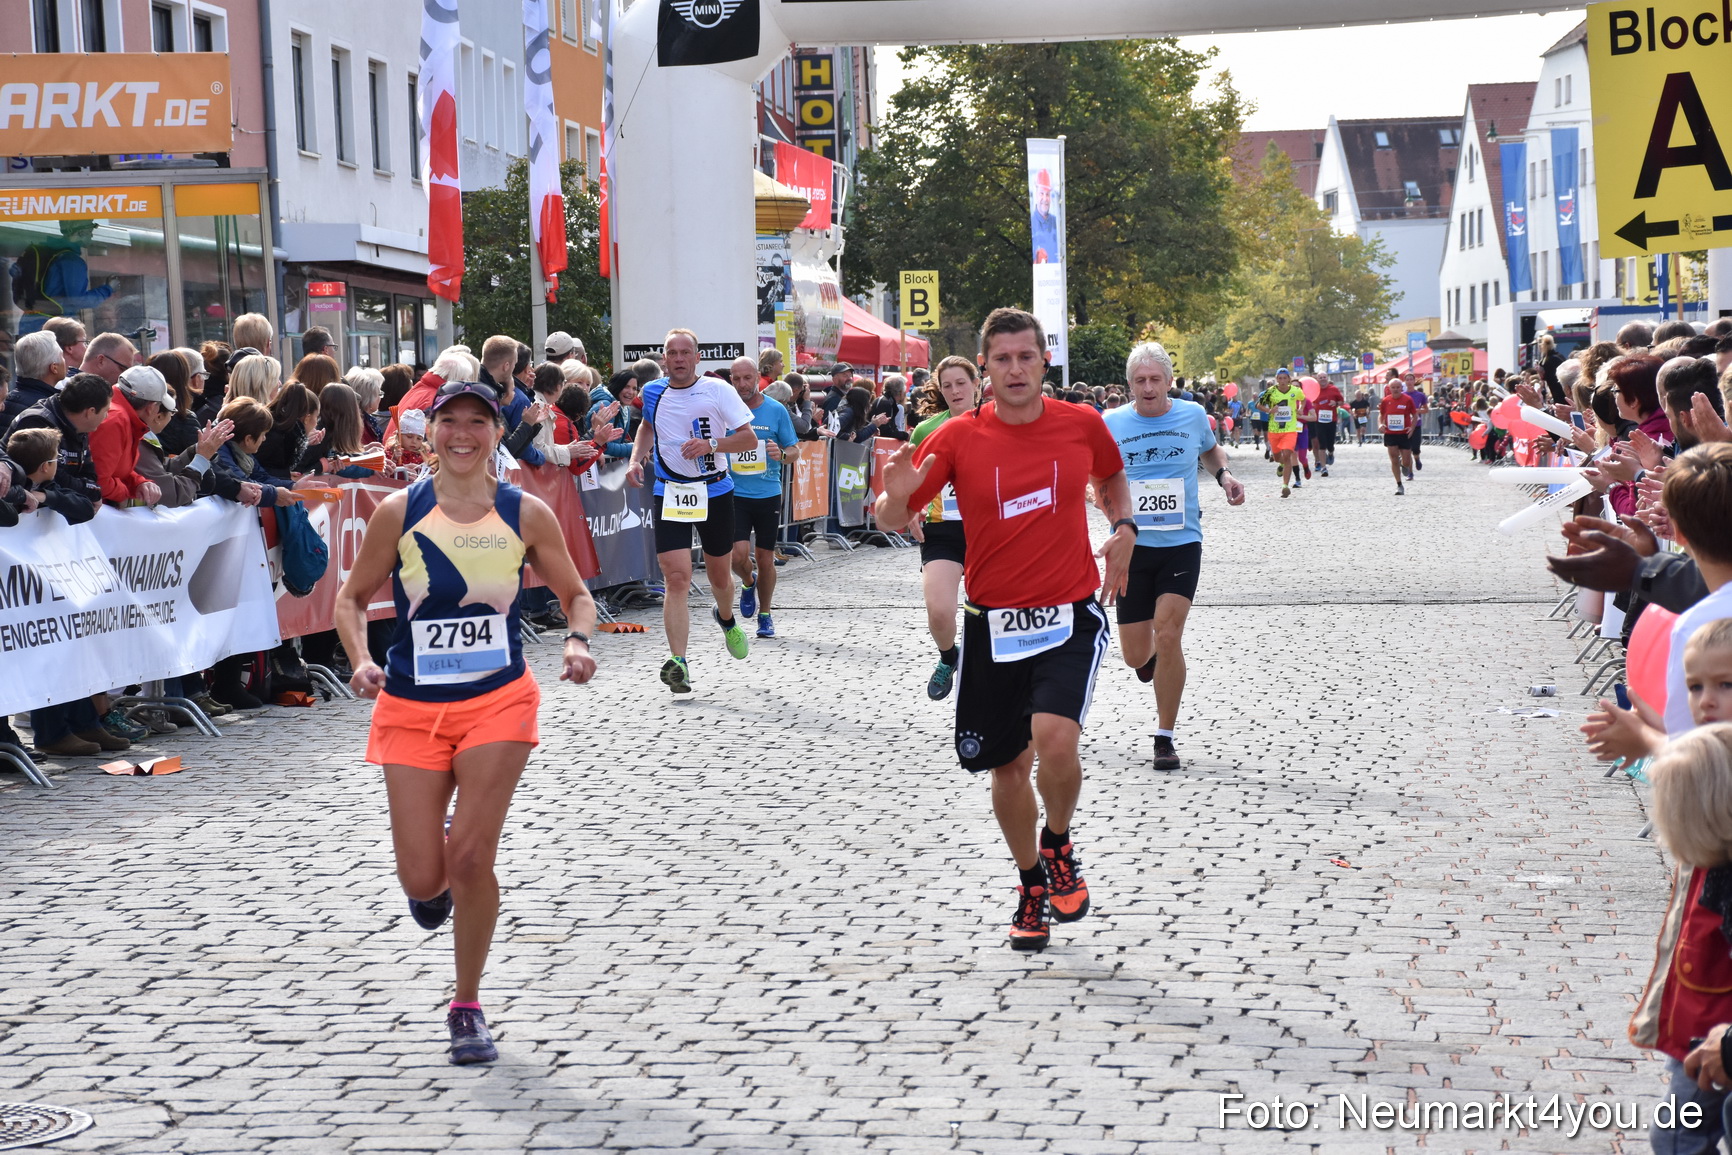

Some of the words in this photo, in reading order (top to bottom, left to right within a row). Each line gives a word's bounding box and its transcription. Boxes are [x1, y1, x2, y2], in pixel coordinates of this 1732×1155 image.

[694, 4, 720, 15] MINI
[1609, 0, 1732, 55] Block
[1634, 72, 1732, 199] A
[904, 273, 934, 284] Block
[910, 289, 929, 316] B
[1461, 359, 1470, 371] D
[1220, 368, 1229, 380] D
[699, 417, 716, 472] HUER
[737, 451, 757, 462] 205
[674, 494, 698, 507] 140
[1016, 497, 1039, 510] DEHN
[1138, 495, 1177, 511] 2365
[453, 534, 507, 549] oiselle
[1001, 606, 1061, 632] 2062
[426, 619, 492, 648] 2794
[1018, 636, 1049, 647] Thomas
[428, 659, 463, 671] KELLY
